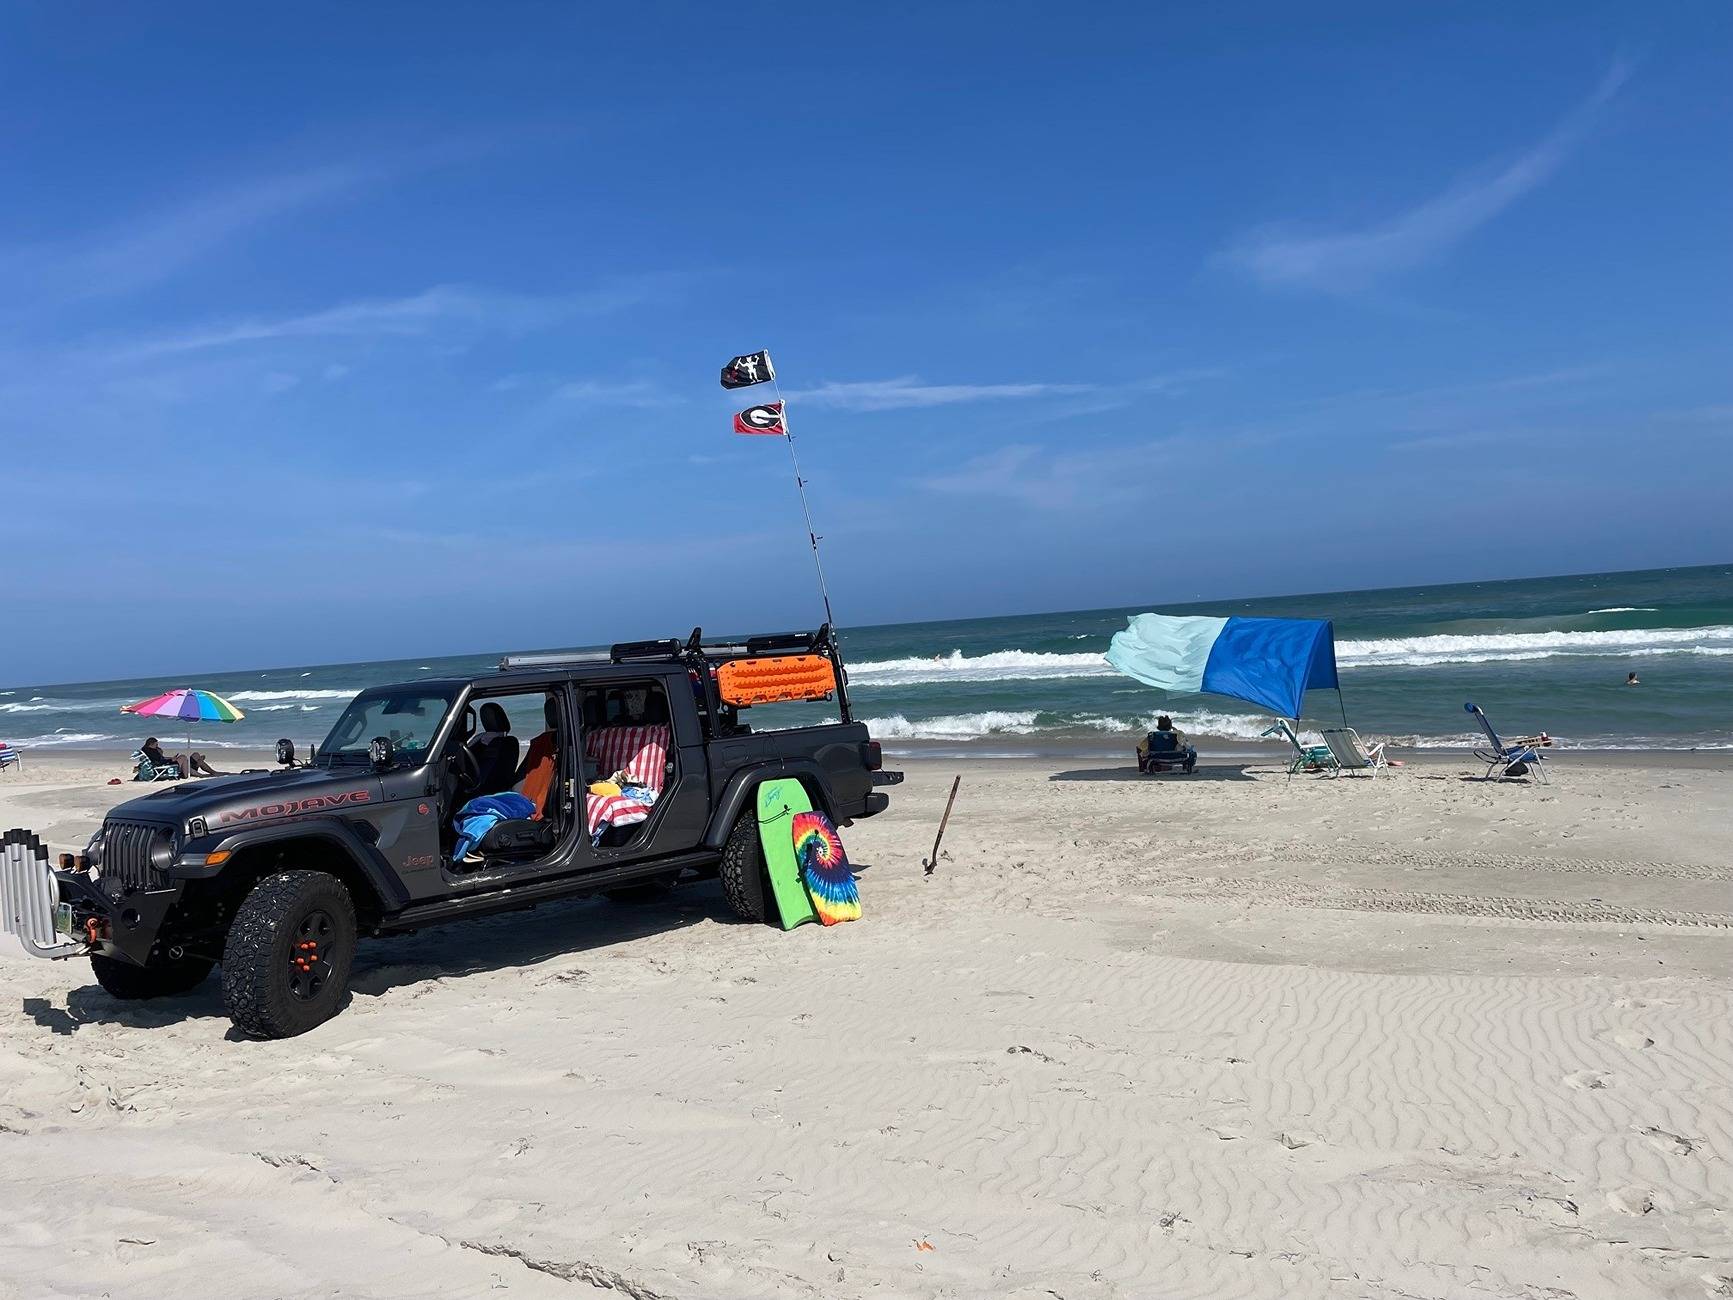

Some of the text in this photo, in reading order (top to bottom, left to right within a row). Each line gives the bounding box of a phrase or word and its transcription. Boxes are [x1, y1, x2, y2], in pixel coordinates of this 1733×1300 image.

[750, 409, 780, 425] G
[219, 790, 370, 824] MOJAVE
[401, 855, 433, 868] Jeep
